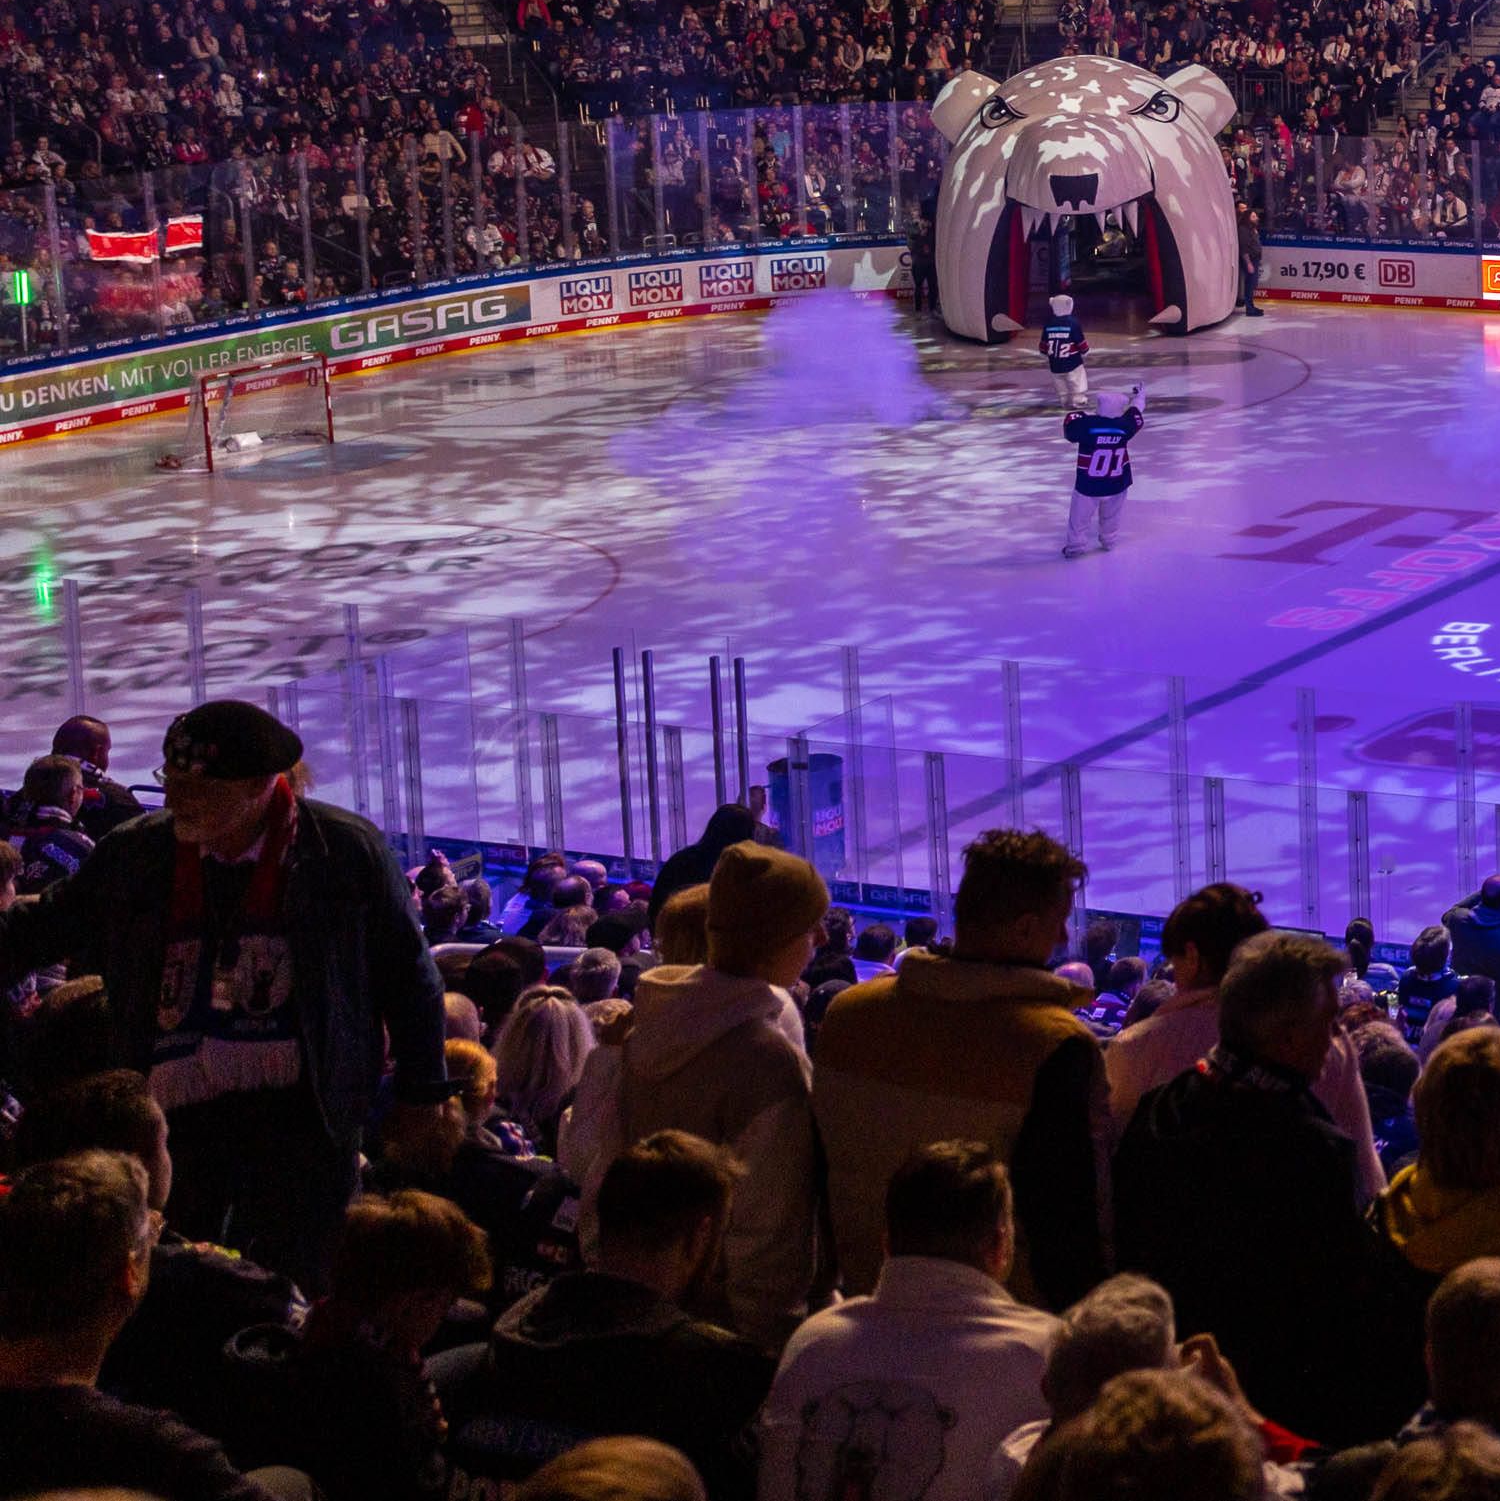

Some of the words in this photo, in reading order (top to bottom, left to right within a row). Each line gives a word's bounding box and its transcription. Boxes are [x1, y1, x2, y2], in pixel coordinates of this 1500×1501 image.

[704, 243, 741, 252] GASAG
[1408, 238, 1440, 247] GASAG
[577, 256, 611, 267] GASAG
[772, 257, 824, 274] LIQUI
[456, 273, 490, 284] GASAG
[629, 269, 682, 286] LIQUI
[701, 262, 752, 280] LIQUI
[1280, 263, 1298, 277] ab
[1302, 261, 1349, 281] 17,90
[1354, 263, 1367, 281] €
[1383, 263, 1411, 284] DB
[562, 277, 611, 296] LIQUI
[702, 280, 753, 297] MOLY
[773, 274, 825, 290] MOLY
[631, 286, 683, 305] MOLY
[266, 305, 299, 318] GASAG
[562, 296, 613, 314] MOLY
[330, 295, 507, 350] GASAG
[7, 352, 46, 366] GASAG
[22, 375, 116, 410] DENKEN.
[120, 365, 155, 389] MIT
[159, 351, 232, 379] VOLLER
[237, 333, 318, 363] ENERGIE.
[1096, 435, 1121, 444] BULLY
[1088, 449, 1125, 477] 01
